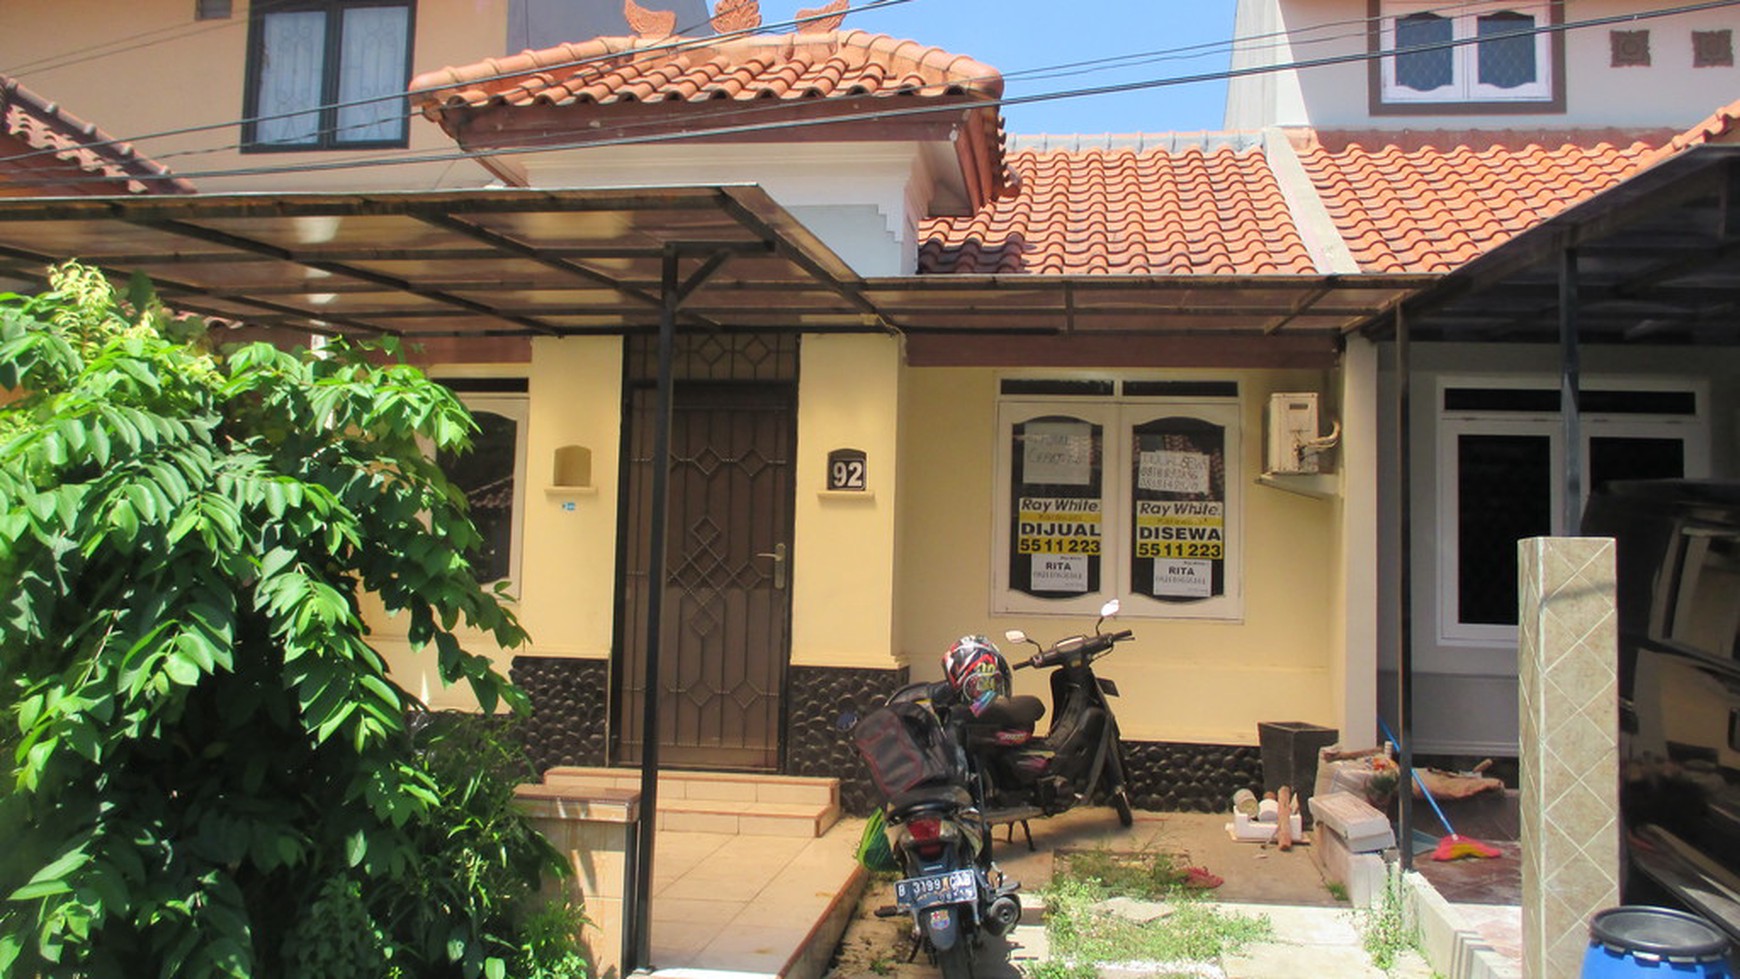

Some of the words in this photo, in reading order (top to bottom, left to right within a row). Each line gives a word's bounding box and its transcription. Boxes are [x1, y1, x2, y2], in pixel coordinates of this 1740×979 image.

[833, 461, 863, 487] 92
[1021, 499, 1052, 513] Ray
[1140, 502, 1171, 517] Ray
[1021, 522, 1101, 537] DIJUAL
[1139, 526, 1221, 541] DISEWA
[1045, 561, 1072, 571] RITA
[1168, 566, 1195, 576] RITA
[898, 883, 906, 897] B
